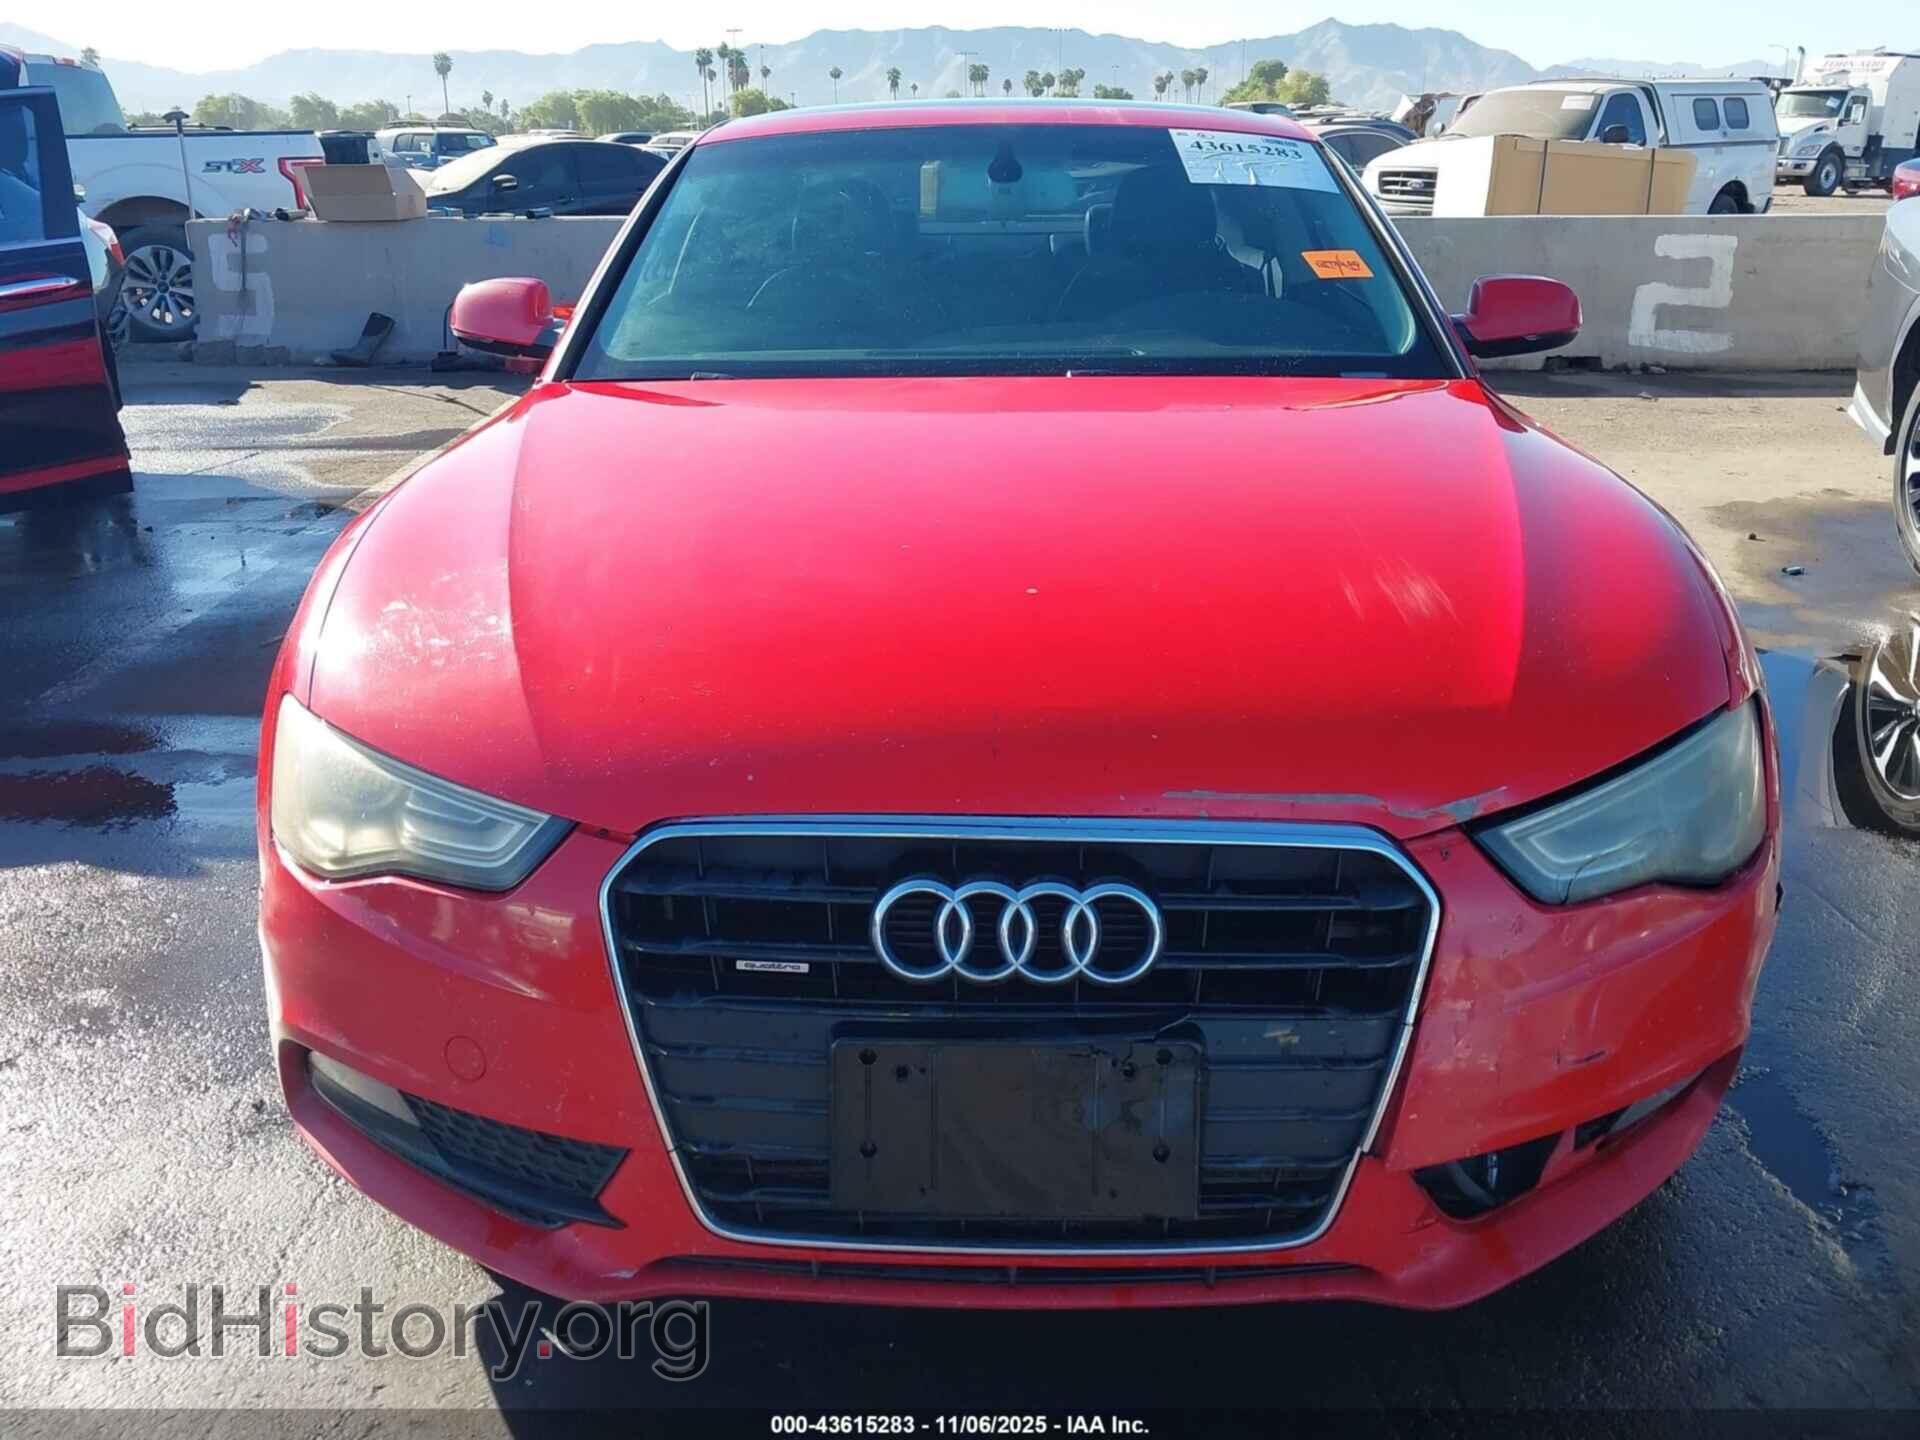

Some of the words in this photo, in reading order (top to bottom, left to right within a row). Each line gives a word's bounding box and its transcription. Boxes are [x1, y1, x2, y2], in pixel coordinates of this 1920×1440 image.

[1190, 140, 1303, 160] 43615283
[201, 158, 266, 174] STX
[1628, 234, 1738, 352] 2
